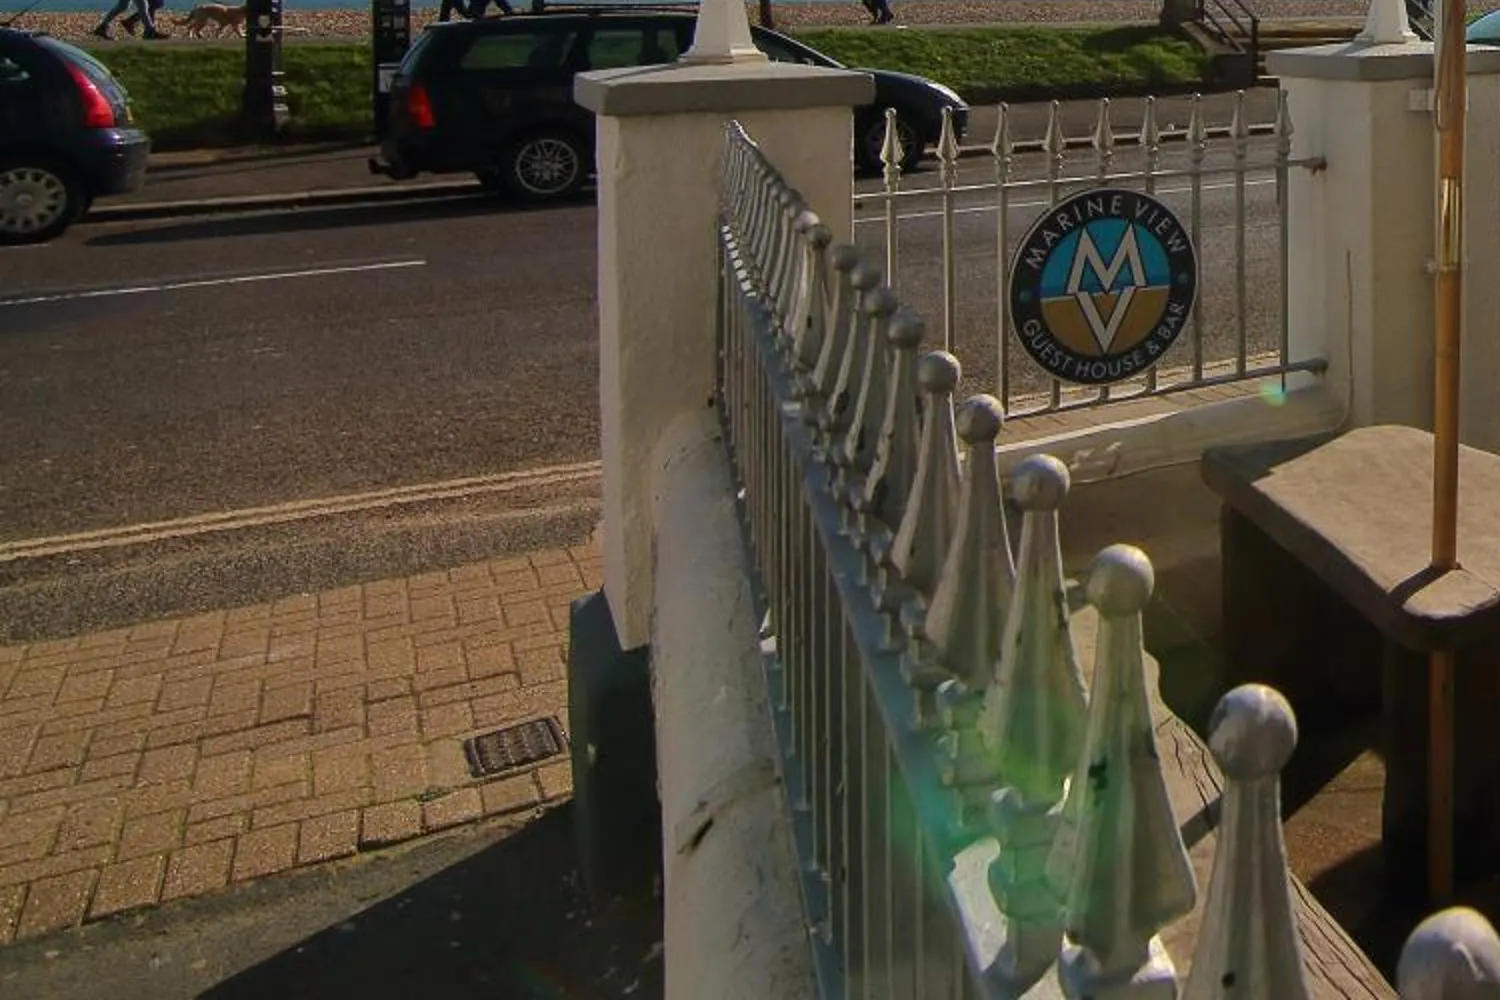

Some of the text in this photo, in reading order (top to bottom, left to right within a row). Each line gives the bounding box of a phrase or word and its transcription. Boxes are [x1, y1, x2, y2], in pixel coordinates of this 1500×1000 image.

[1026, 195, 1187, 270] MARINE VIEW
[1023, 319, 1071, 370] GUEST
[1075, 350, 1144, 378] HOUSE
[1158, 303, 1184, 344] BAR
